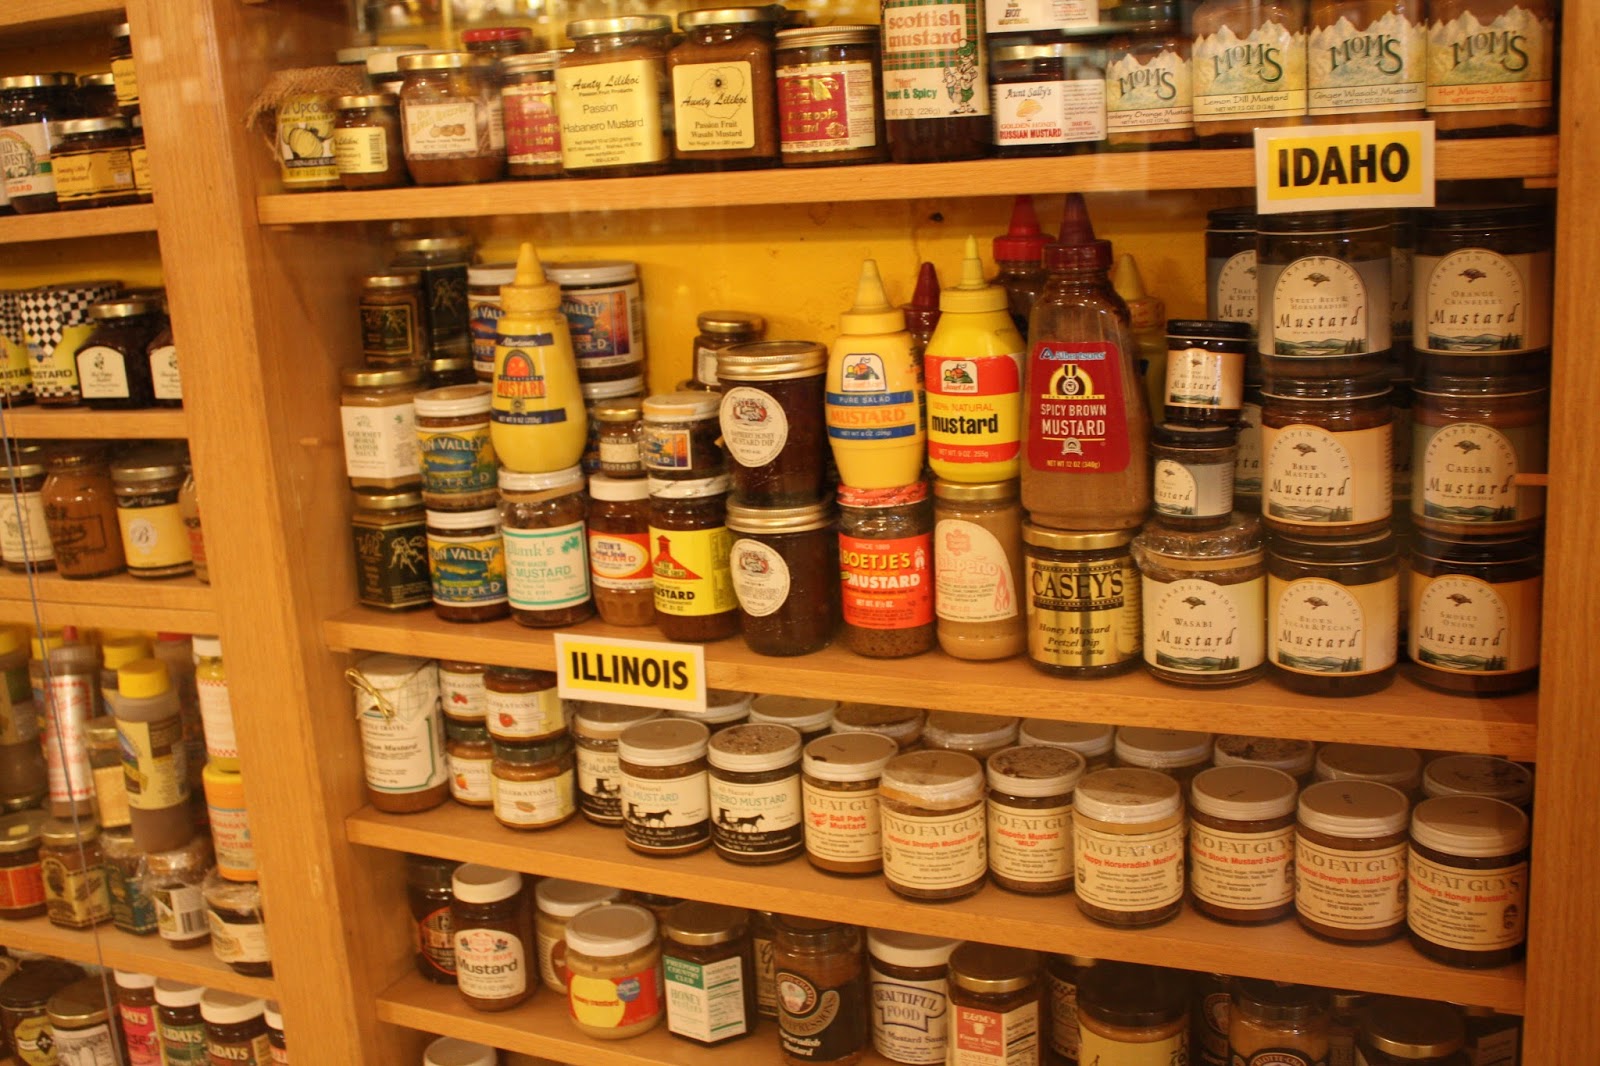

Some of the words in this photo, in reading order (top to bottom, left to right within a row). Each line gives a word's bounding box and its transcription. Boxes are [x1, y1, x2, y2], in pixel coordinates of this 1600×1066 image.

[889, 10, 961, 29] scottish
[889, 28, 961, 47] mustard
[1328, 34, 1403, 75] MOM'S
[1450, 30, 1528, 72] MOM'S
[1213, 43, 1283, 83] MOM'S
[571, 78, 601, 91] Aunty
[605, 74, 639, 87] Lilikoi
[1119, 67, 1176, 100] MOM'S
[681, 96, 710, 107] Aunty
[715, 92, 748, 105] Lilikoi
[903, 89, 910, 98] &
[913, 88, 937, 100] Spicy
[1005, 88, 1025, 99] Aunt
[1027, 86, 1052, 98] Sally's
[1203, 98, 1231, 106] Lemon
[1233, 96, 1249, 104] Dill
[1251, 93, 1289, 103] Mustard
[1313, 91, 1342, 100] Ginger
[1343, 89, 1378, 97] Wasabi
[1380, 87, 1418, 96] Mustard
[583, 103, 618, 114] Passion
[563, 123, 605, 133] Habanero
[607, 118, 644, 129] Mustard
[695, 121, 719, 129] Passion
[721, 120, 737, 128] Fruit
[691, 130, 715, 138] Wasabi
[717, 129, 743, 137] Mustard
[1000, 130, 1029, 140] RUSSIAN
[1030, 128, 1061, 138] MUSTARD
[1278, 142, 1410, 188] IDAHO
[562, 302, 599, 317] VALLEY
[1276, 305, 1363, 328] Mustard
[1430, 302, 1520, 324] Mustard
[498, 380, 545, 396] MUSTARD
[862, 395, 891, 403] SALAD
[952, 403, 994, 412] NATURAL
[1040, 403, 1066, 416] SPICY
[1068, 404, 1107, 416] BROWN
[830, 409, 906, 424] MUSTARD
[932, 413, 998, 434] mustard
[1042, 419, 1105, 436] MUSTARD
[438, 439, 482, 451] VALLEY
[1285, 470, 1327, 478] MASTER'S
[1446, 463, 1492, 474] CAESAR
[1270, 477, 1351, 496] Mustard
[1425, 474, 1514, 494] Mustard
[450, 547, 494, 561] VALLEY
[843, 550, 911, 570] BOETJE'S
[516, 566, 571, 578] MUSTARD
[848, 573, 920, 589] MUSTARD
[1032, 569, 1124, 600] CASEY'S
[1039, 623, 1066, 635] Honey
[1069, 624, 1110, 635] Mustard
[1173, 617, 1213, 628] WASABI
[1048, 637, 1079, 648] Pretzel
[1081, 638, 1100, 649] Dip
[1157, 626, 1237, 647] Mustard
[1279, 629, 1361, 648] Mustard
[1420, 626, 1506, 647] Mustard
[571, 651, 689, 691] ILLINOIS
[634, 791, 678, 802] MUSTARD
[740, 793, 787, 807] MUSTARD
[822, 798, 845, 811] FAT
[829, 814, 845, 822] Ball
[848, 814, 866, 822] Park
[830, 821, 866, 830] Mustard
[883, 819, 909, 836] TWO
[919, 823, 947, 837] FAT
[950, 814, 985, 835] GUYS
[1011, 817, 1042, 830] FAT
[912, 838, 939, 850] Strength
[942, 836, 966, 848] Mustard
[1028, 831, 1059, 840] Mustard
[1078, 836, 1112, 856] TWO
[1117, 845, 1148, 858] FAT
[1219, 841, 1249, 854] FAT
[1253, 837, 1296, 854] GUYS
[1103, 858, 1151, 869] Horseradish
[1153, 853, 1177, 867] Mustard
[1209, 852, 1228, 863] Stock
[1231, 855, 1263, 865] Mustard
[1266, 852, 1287, 863] Sauce
[1329, 858, 1362, 873] FAT
[1366, 852, 1408, 873] GUYS
[1319, 873, 1349, 885] Strength
[1351, 875, 1380, 885] Mustard
[1382, 872, 1400, 883] Sauce
[1432, 872, 1464, 889] FAT
[1467, 875, 1520, 894] GUYS
[1445, 891, 1472, 903] Honey
[1475, 893, 1508, 903] Mustard
[457, 956, 518, 975] Mustard
[675, 974, 694, 984] CLUB
[875, 990, 938, 1011] BEAUTIFUL
[887, 1006, 920, 1020] FOOD
[888, 1031, 922, 1043] Mustard
